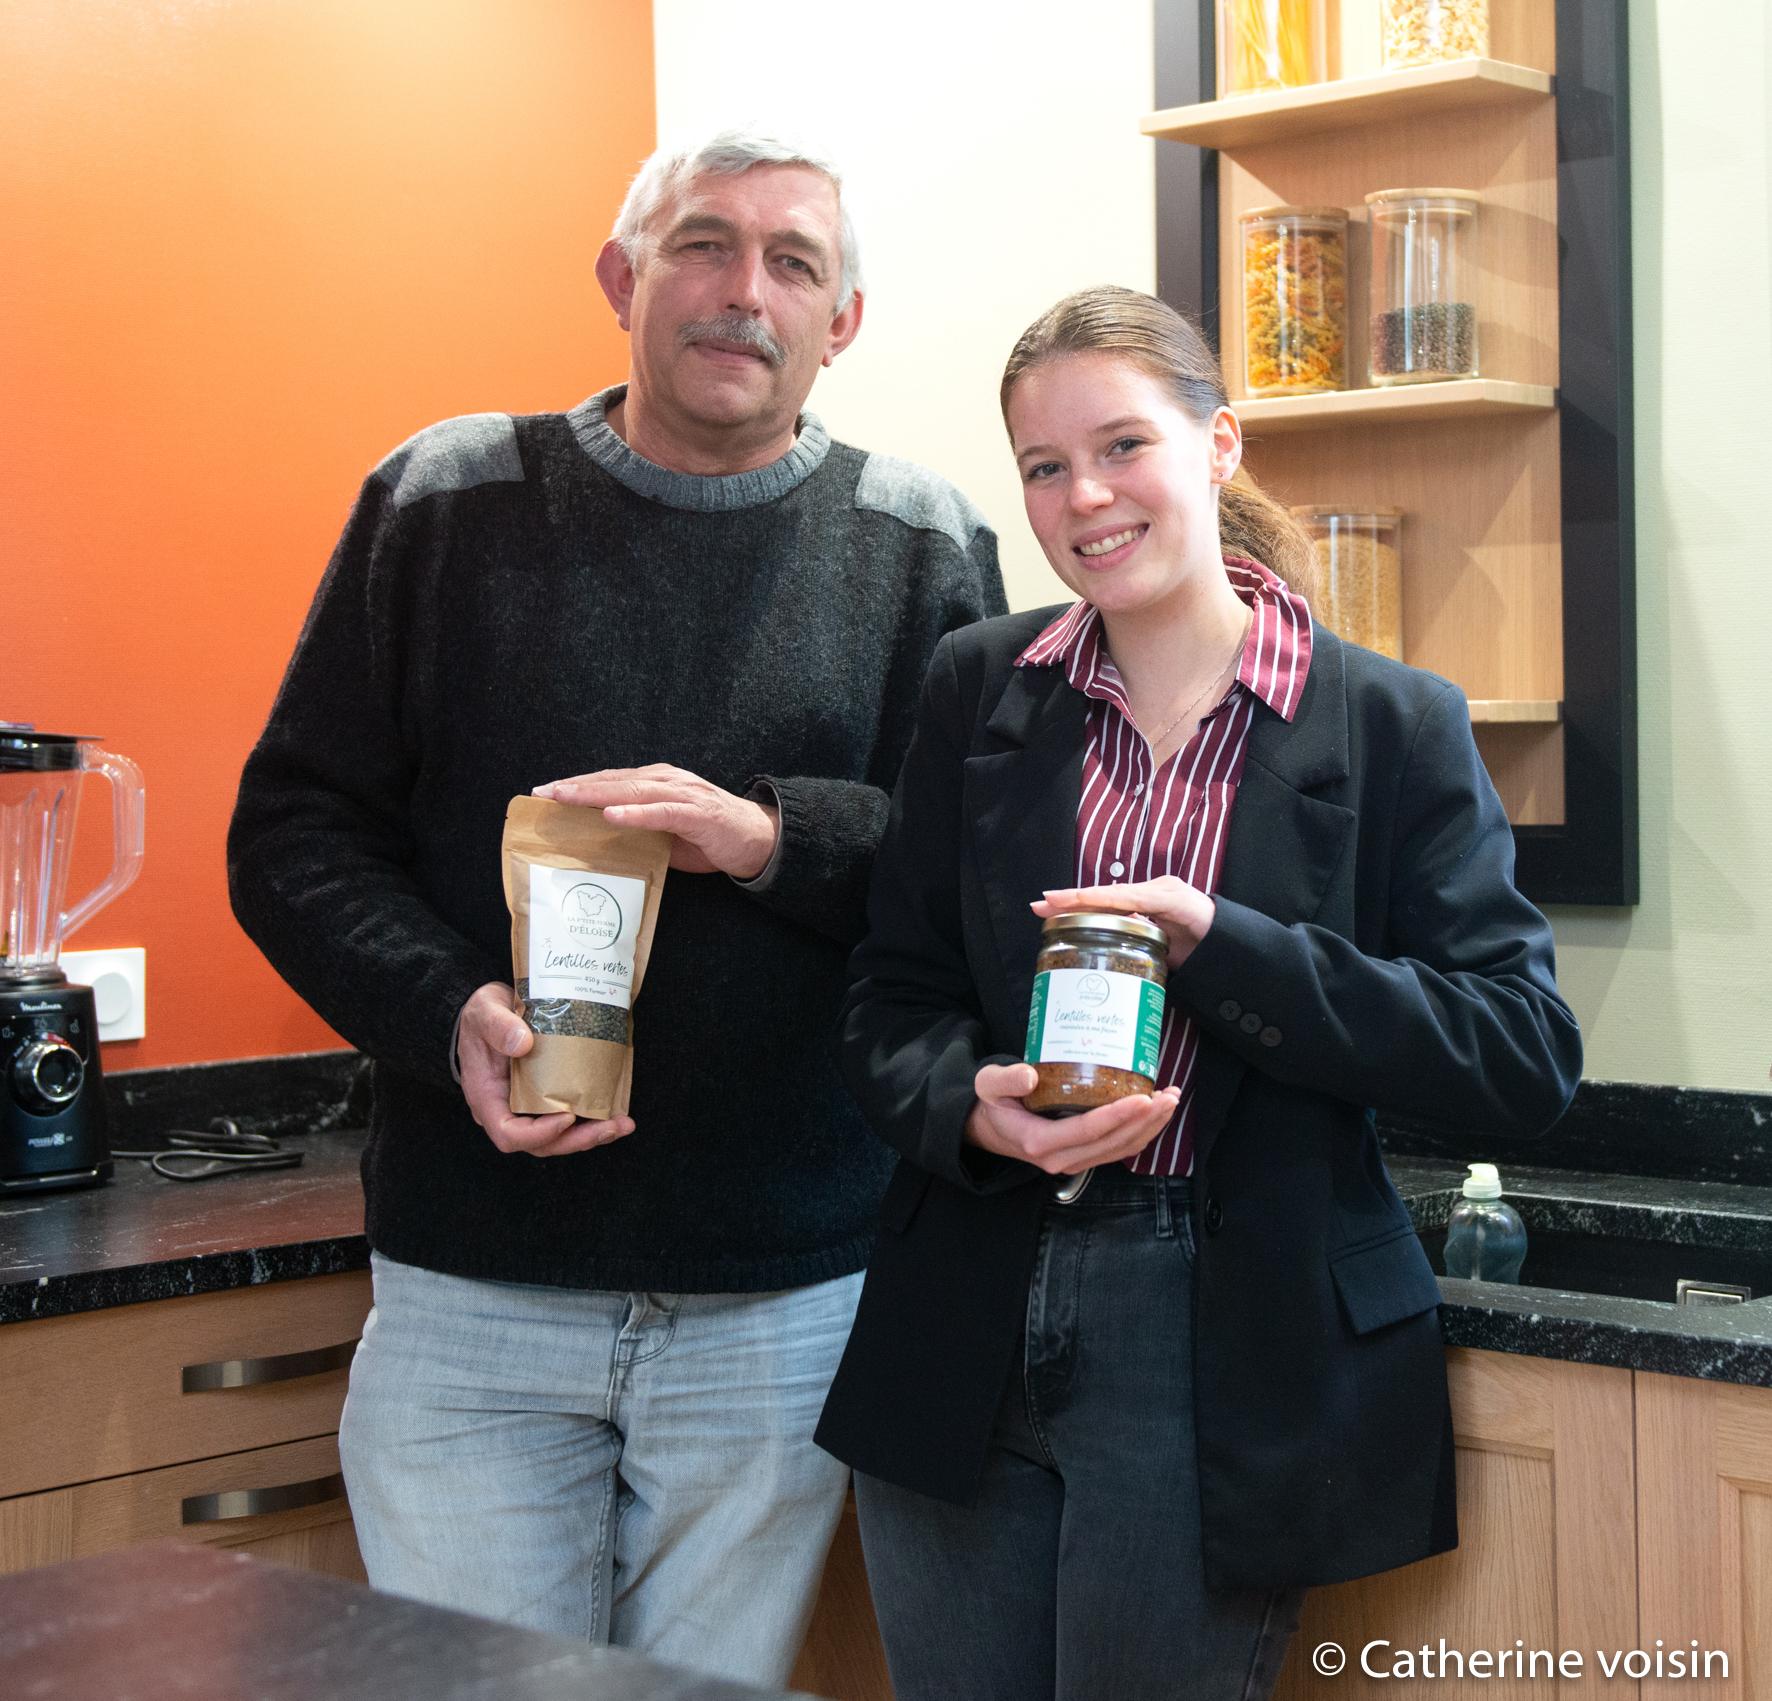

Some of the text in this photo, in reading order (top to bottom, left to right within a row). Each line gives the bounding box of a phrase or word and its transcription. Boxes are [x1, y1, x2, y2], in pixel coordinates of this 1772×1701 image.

[569, 924, 614, 938] D'ÉLOÏSE
[544, 950, 629, 977] Lentilles vertes
[1054, 1007, 1126, 1026] Lentilles vertes
